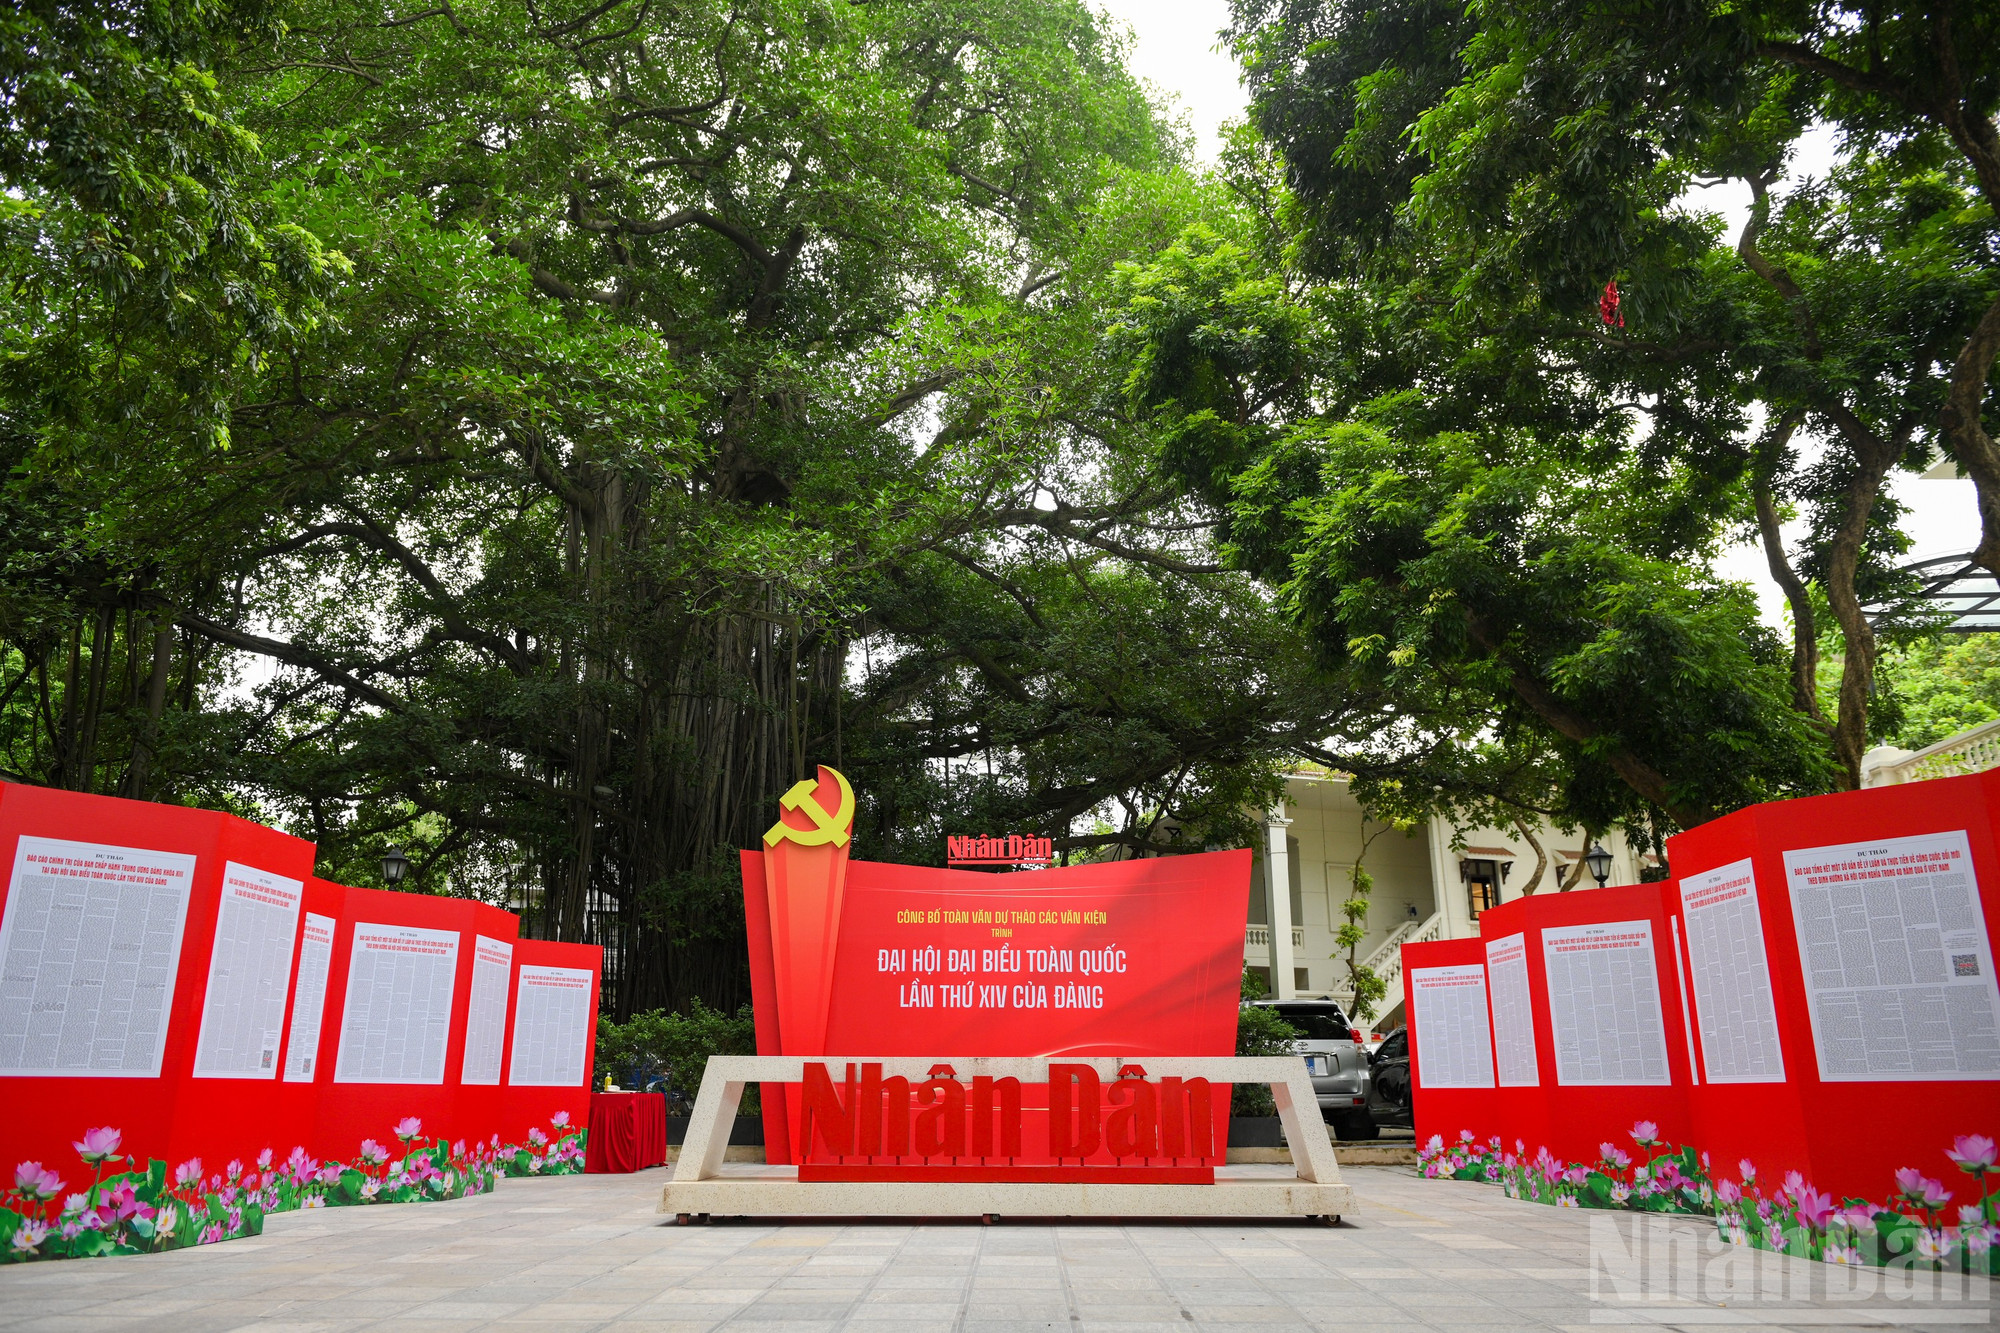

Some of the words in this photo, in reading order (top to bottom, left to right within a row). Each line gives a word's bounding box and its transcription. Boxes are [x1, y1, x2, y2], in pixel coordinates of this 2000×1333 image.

[948, 834, 1005, 858] Nhân
[1009, 834, 1052, 858] Dân
[897, 908, 925, 924] CÔNG
[927, 908, 942, 924] BỐ
[943, 908, 970, 924] TOÀN
[972, 908, 992, 924] VĂN
[995, 910, 1009, 926] DỰ
[1011, 908, 1036, 924] THẢO
[1038, 908, 1058, 924] CÁC
[1060, 908, 1081, 924] VĂN
[1084, 909, 1107, 926] KIỆN
[991, 927, 1012, 938] TRÌNH
[877, 949, 906, 974] ĐẠI
[912, 945, 941, 975] HỘI
[947, 949, 976, 974] ĐẠI
[982, 942, 1021, 973] BIỂU
[1026, 946, 1073, 973] TOÀN
[1079, 943, 1127, 976] QUỐC
[900, 978, 934, 1008] LẦN
[939, 981, 975, 1008] THỨ
[979, 985, 1007, 1008] XIV
[1012, 981, 1048, 1008] CỦA
[1054, 981, 1104, 1008] ĐẢNG
[802, 1062, 1022, 1158] Nhân
[1049, 1063, 1215, 1159] Dân
